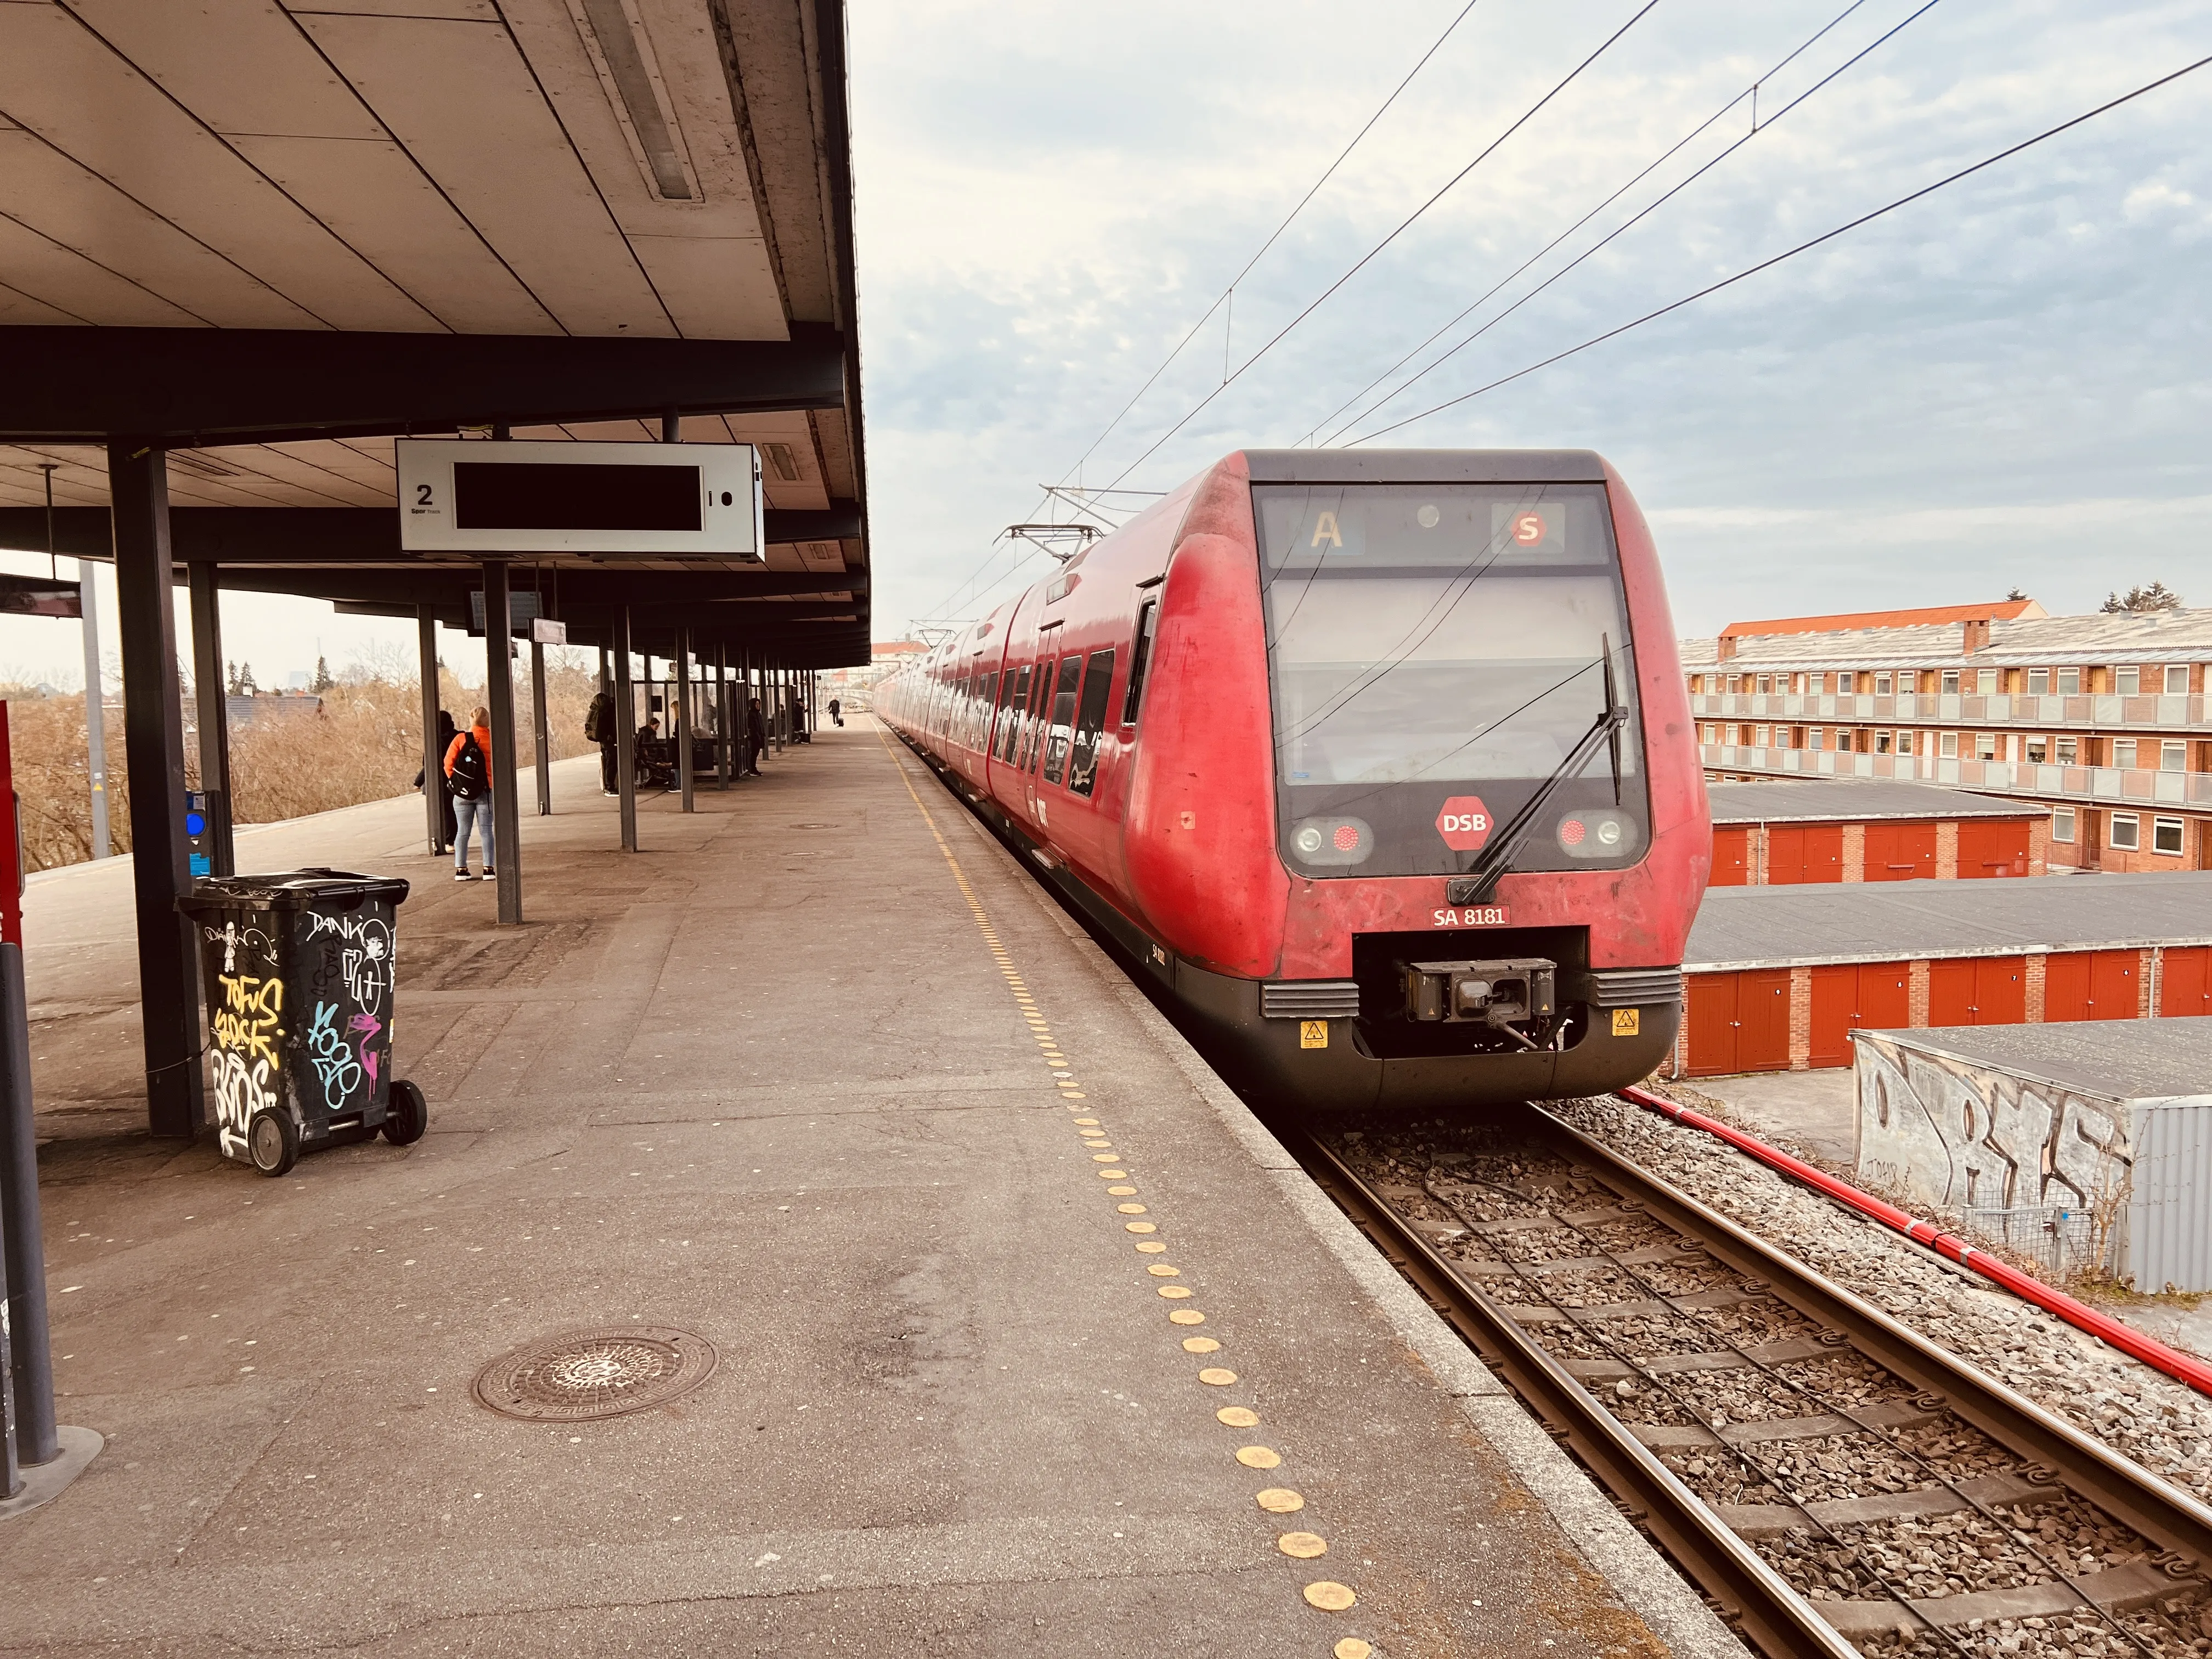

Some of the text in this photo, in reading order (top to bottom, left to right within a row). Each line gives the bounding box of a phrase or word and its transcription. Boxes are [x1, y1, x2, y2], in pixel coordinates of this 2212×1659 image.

[417, 484, 433, 505] 2
[1311, 511, 1343, 547] A
[1519, 517, 1538, 540] S
[1443, 814, 1487, 832] DSB
[1434, 908, 1505, 926] SA 8181
